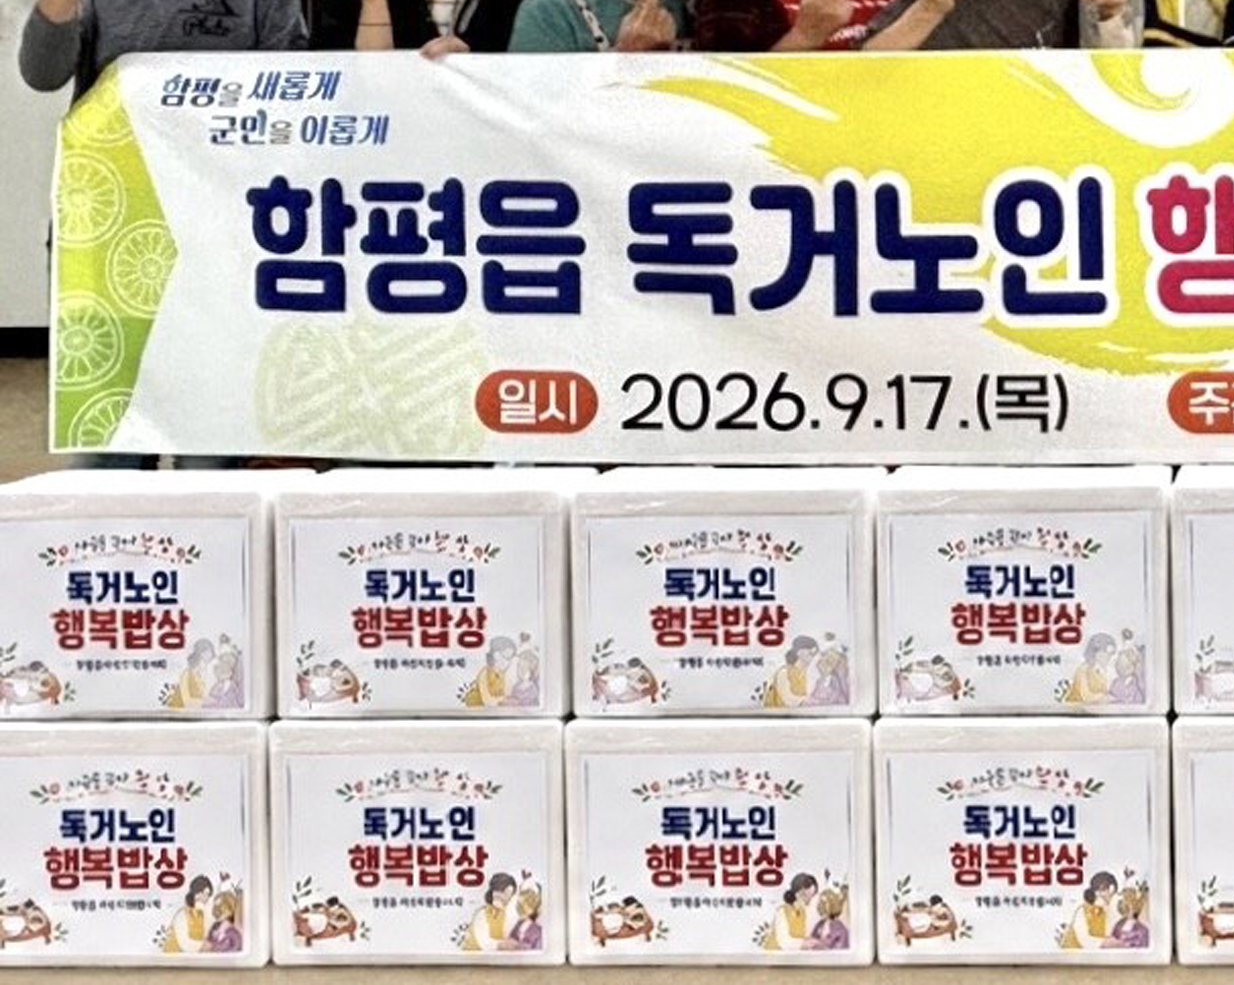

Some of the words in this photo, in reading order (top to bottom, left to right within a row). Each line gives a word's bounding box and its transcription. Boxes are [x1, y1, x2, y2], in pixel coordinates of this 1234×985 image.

[160, 73, 243, 108] 함평을
[248, 71, 341, 101] 새롭게
[210, 109, 291, 145] 군민을
[301, 115, 390, 146] 이롭게
[246, 175, 587, 315] 함평읍
[626, 176, 1107, 317] 독거노인
[499, 379, 578, 425] 일시
[621, 371, 1069, 433] 2026.9.17.(목)
[67, 570, 178, 605] 독거노인
[365, 568, 475, 603] 독거노인
[664, 567, 775, 601] 독거노인
[965, 565, 1075, 599] 독거노인
[51, 608, 190, 651] 행복밥상
[351, 606, 487, 649] 행복밥상
[649, 604, 790, 648] 행복밥상
[951, 602, 1086, 646] 행복밥상
[60, 808, 175, 843] 독거노인
[363, 806, 474, 841] 독거노인
[661, 806, 775, 841] 독거노인
[963, 805, 1075, 839] 독거노인
[43, 846, 188, 891] 행복밥상
[348, 843, 489, 888] 행복밥상
[645, 843, 789, 888] 행복밥상
[949, 842, 1088, 887] 행복밥상
